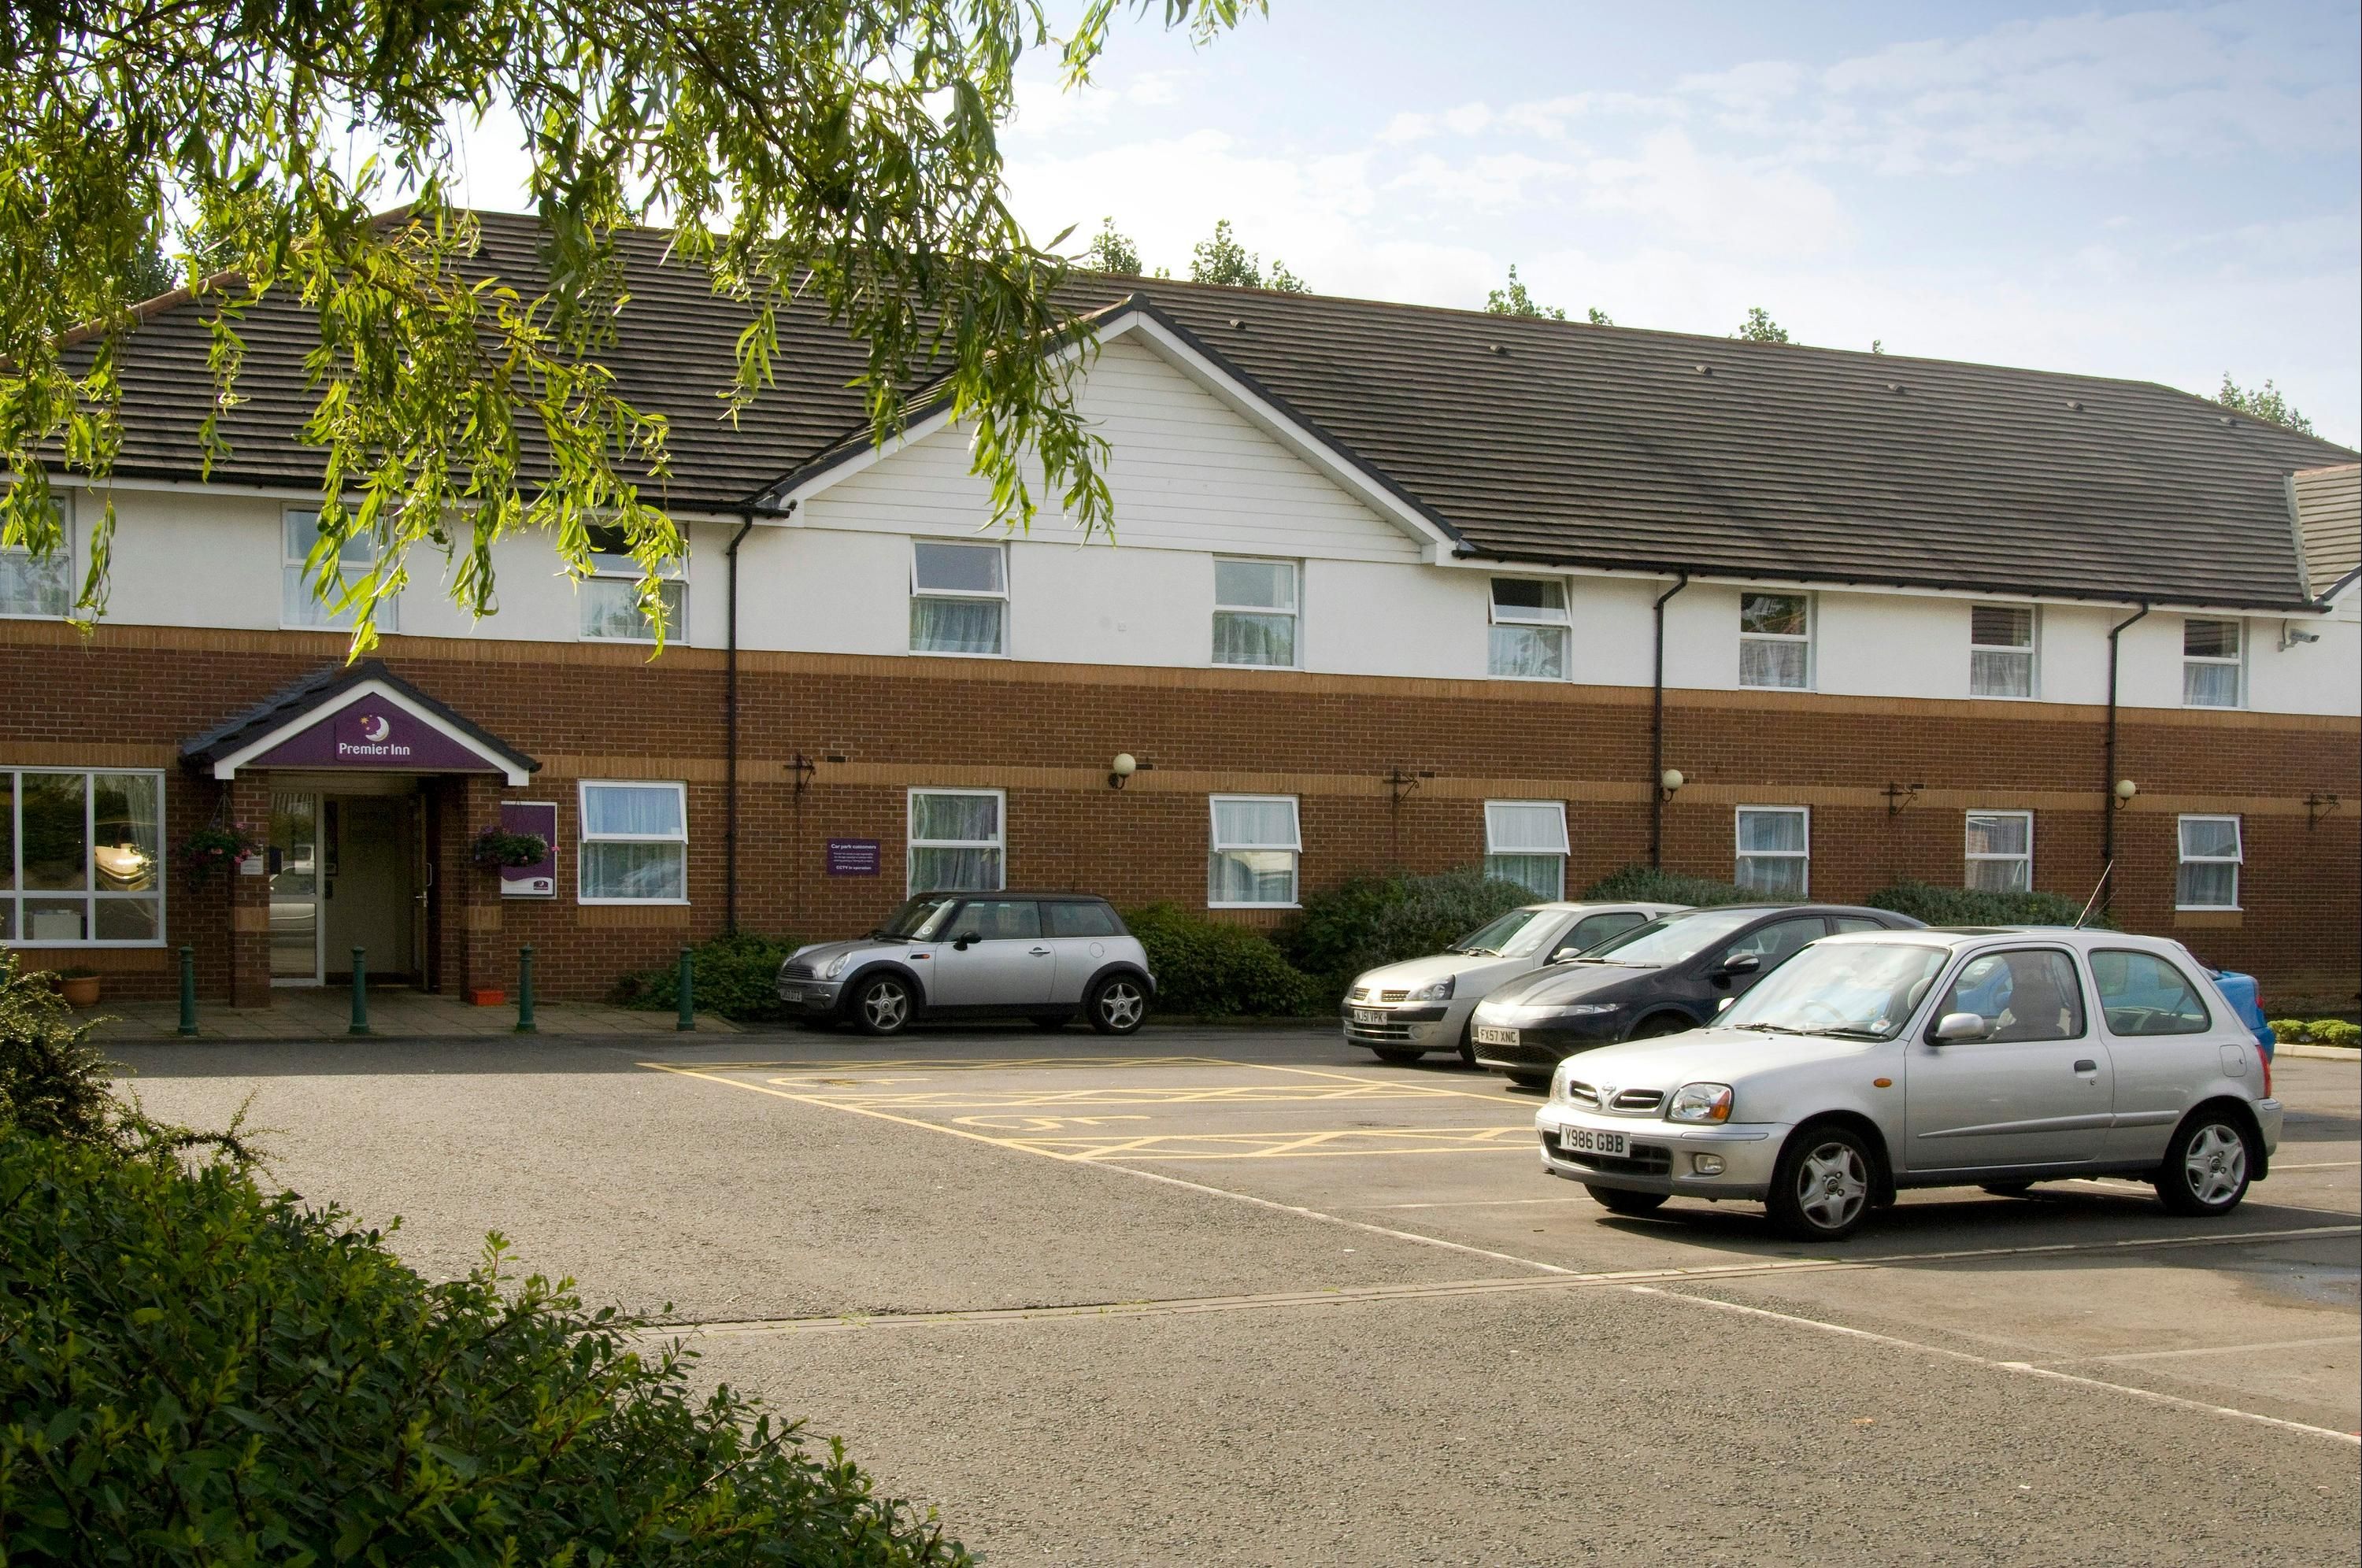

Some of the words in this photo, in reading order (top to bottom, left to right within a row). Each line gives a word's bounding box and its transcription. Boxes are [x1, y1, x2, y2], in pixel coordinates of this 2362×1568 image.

[339, 742, 389, 755] Premier
[391, 744, 410, 755] Inn
[1480, 1029, 1498, 1041] FX57
[1500, 1030, 1516, 1043] XNC
[1565, 1127, 1594, 1149] Y986
[1597, 1133, 1623, 1153] GBB
